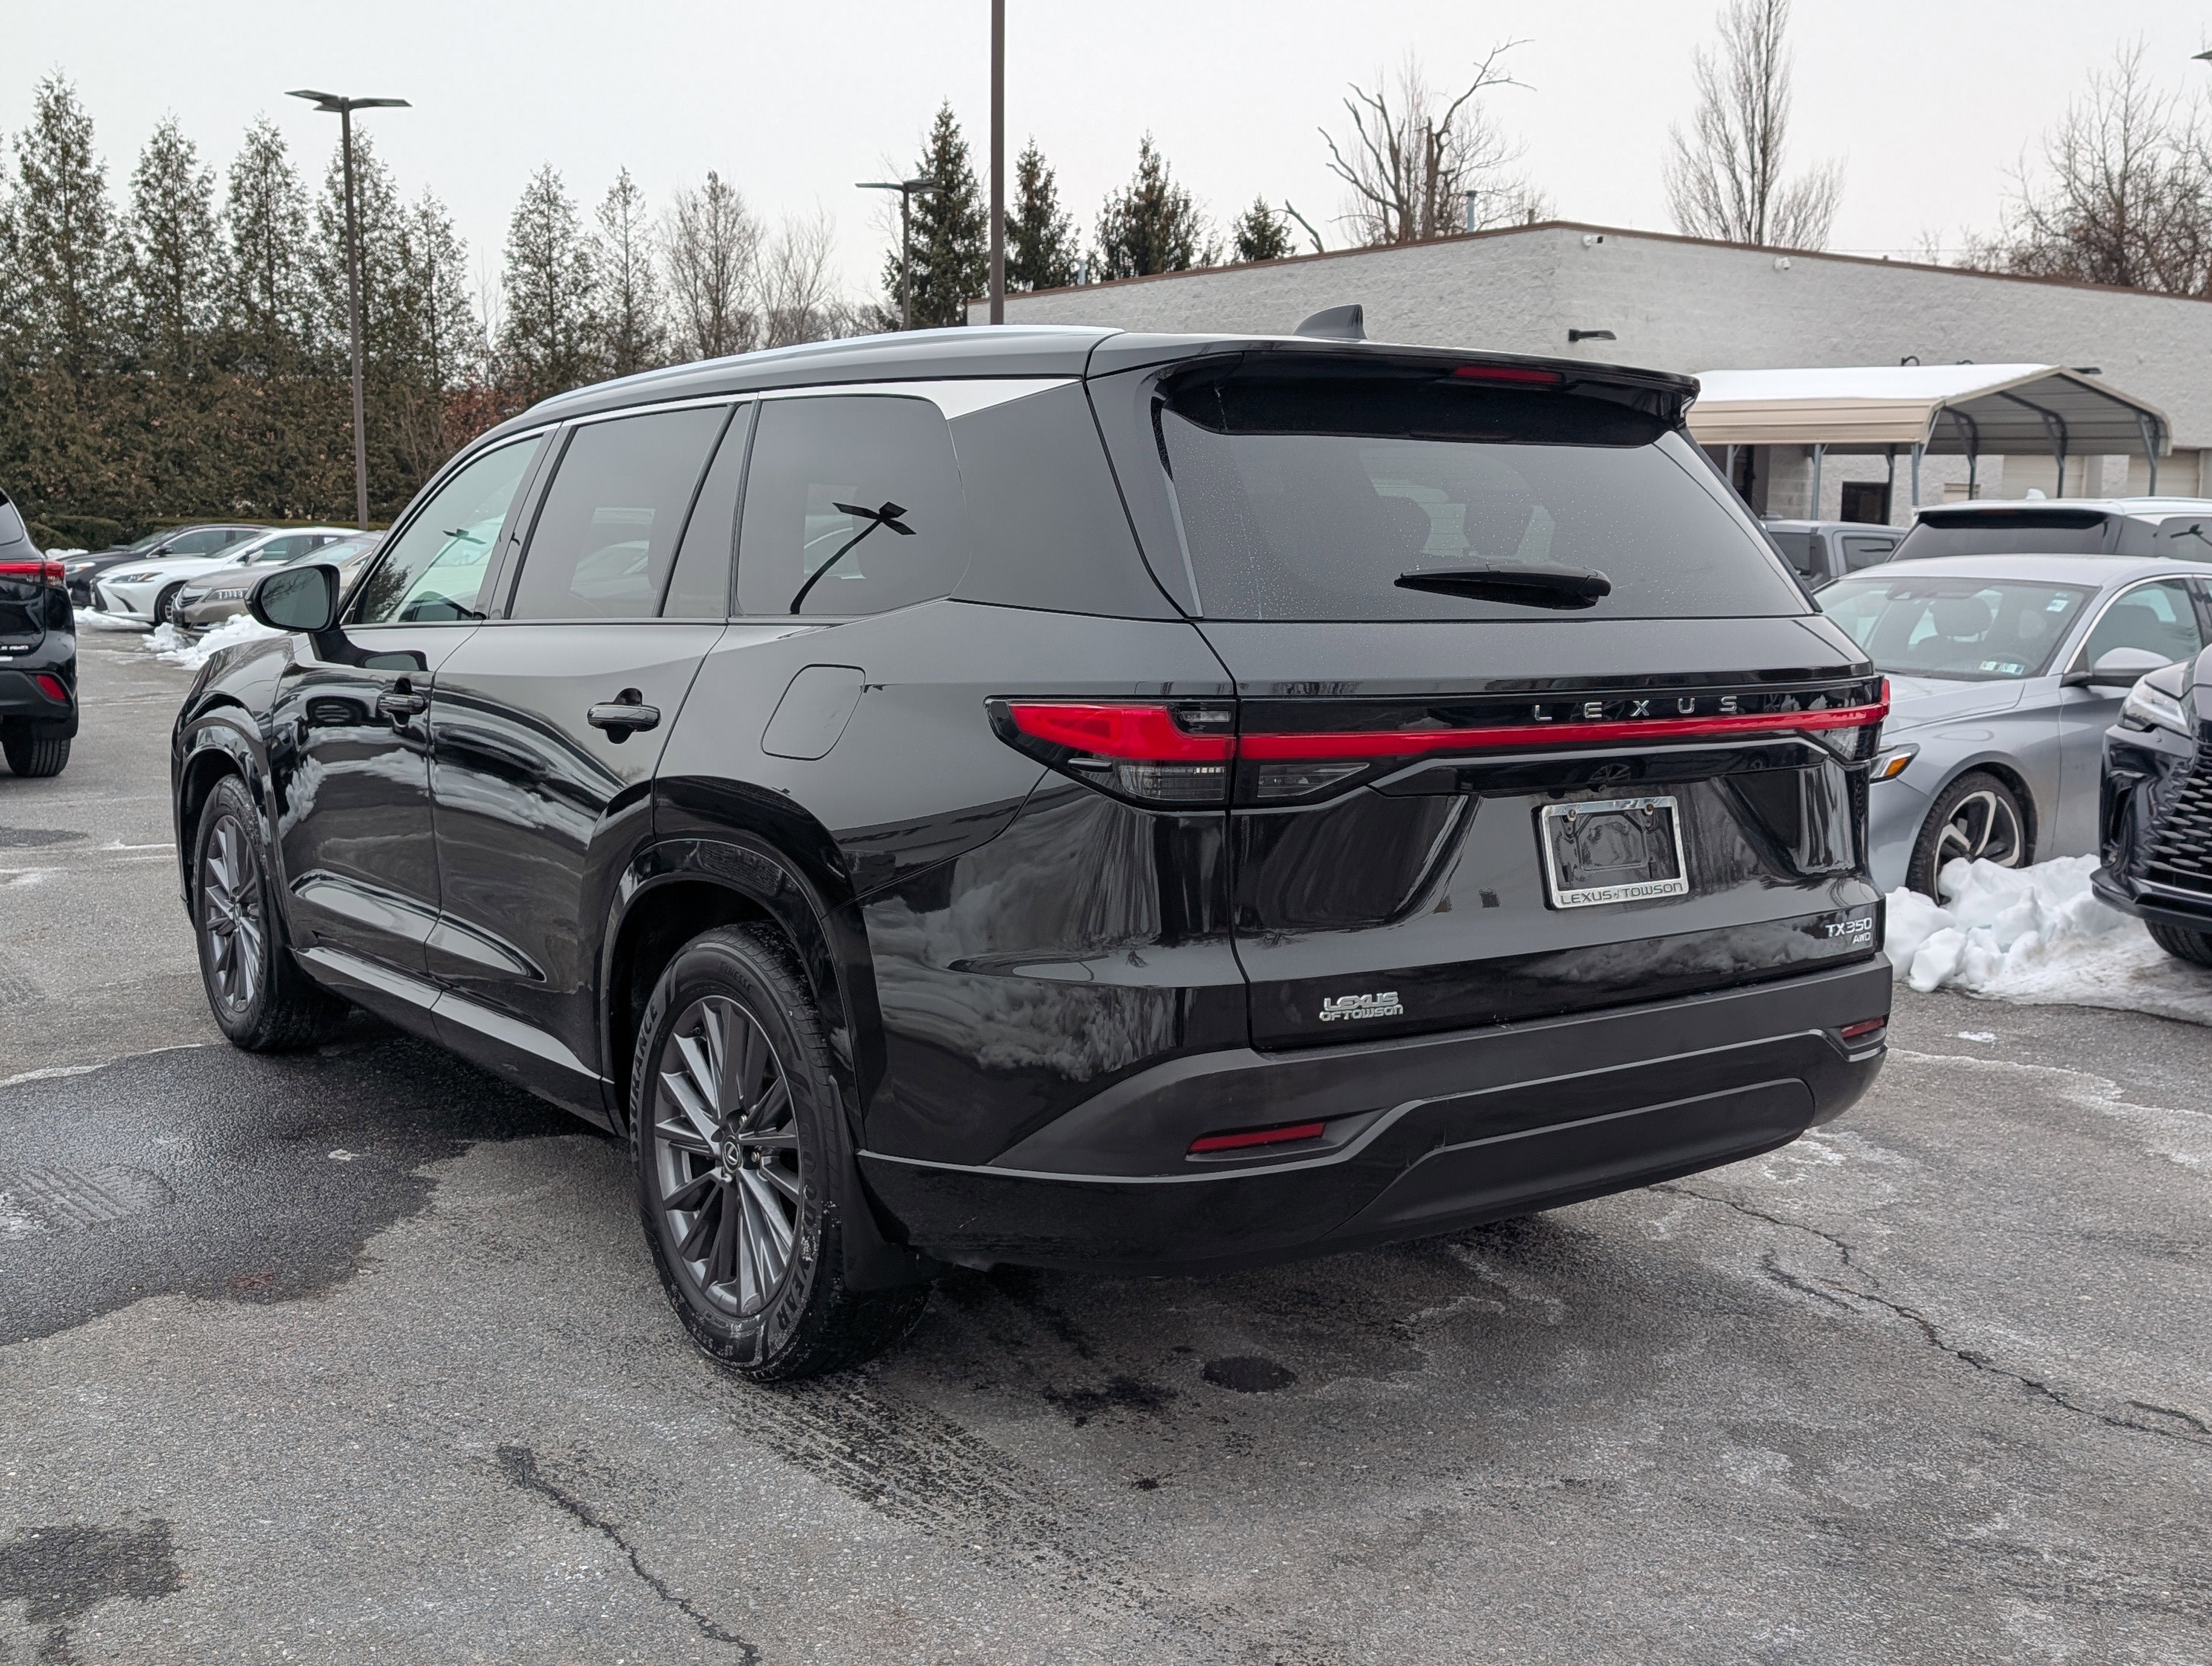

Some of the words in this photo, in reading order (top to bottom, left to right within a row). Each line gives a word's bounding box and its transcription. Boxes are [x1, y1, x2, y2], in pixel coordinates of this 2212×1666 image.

[1533, 696, 1737, 721] LEXUS
[1560, 890, 1612, 905] LEXUS
[1621, 882, 1683, 898] TOWSON
[1852, 932, 1871, 944] AWD
[1323, 991, 1399, 1011] LEXUS
